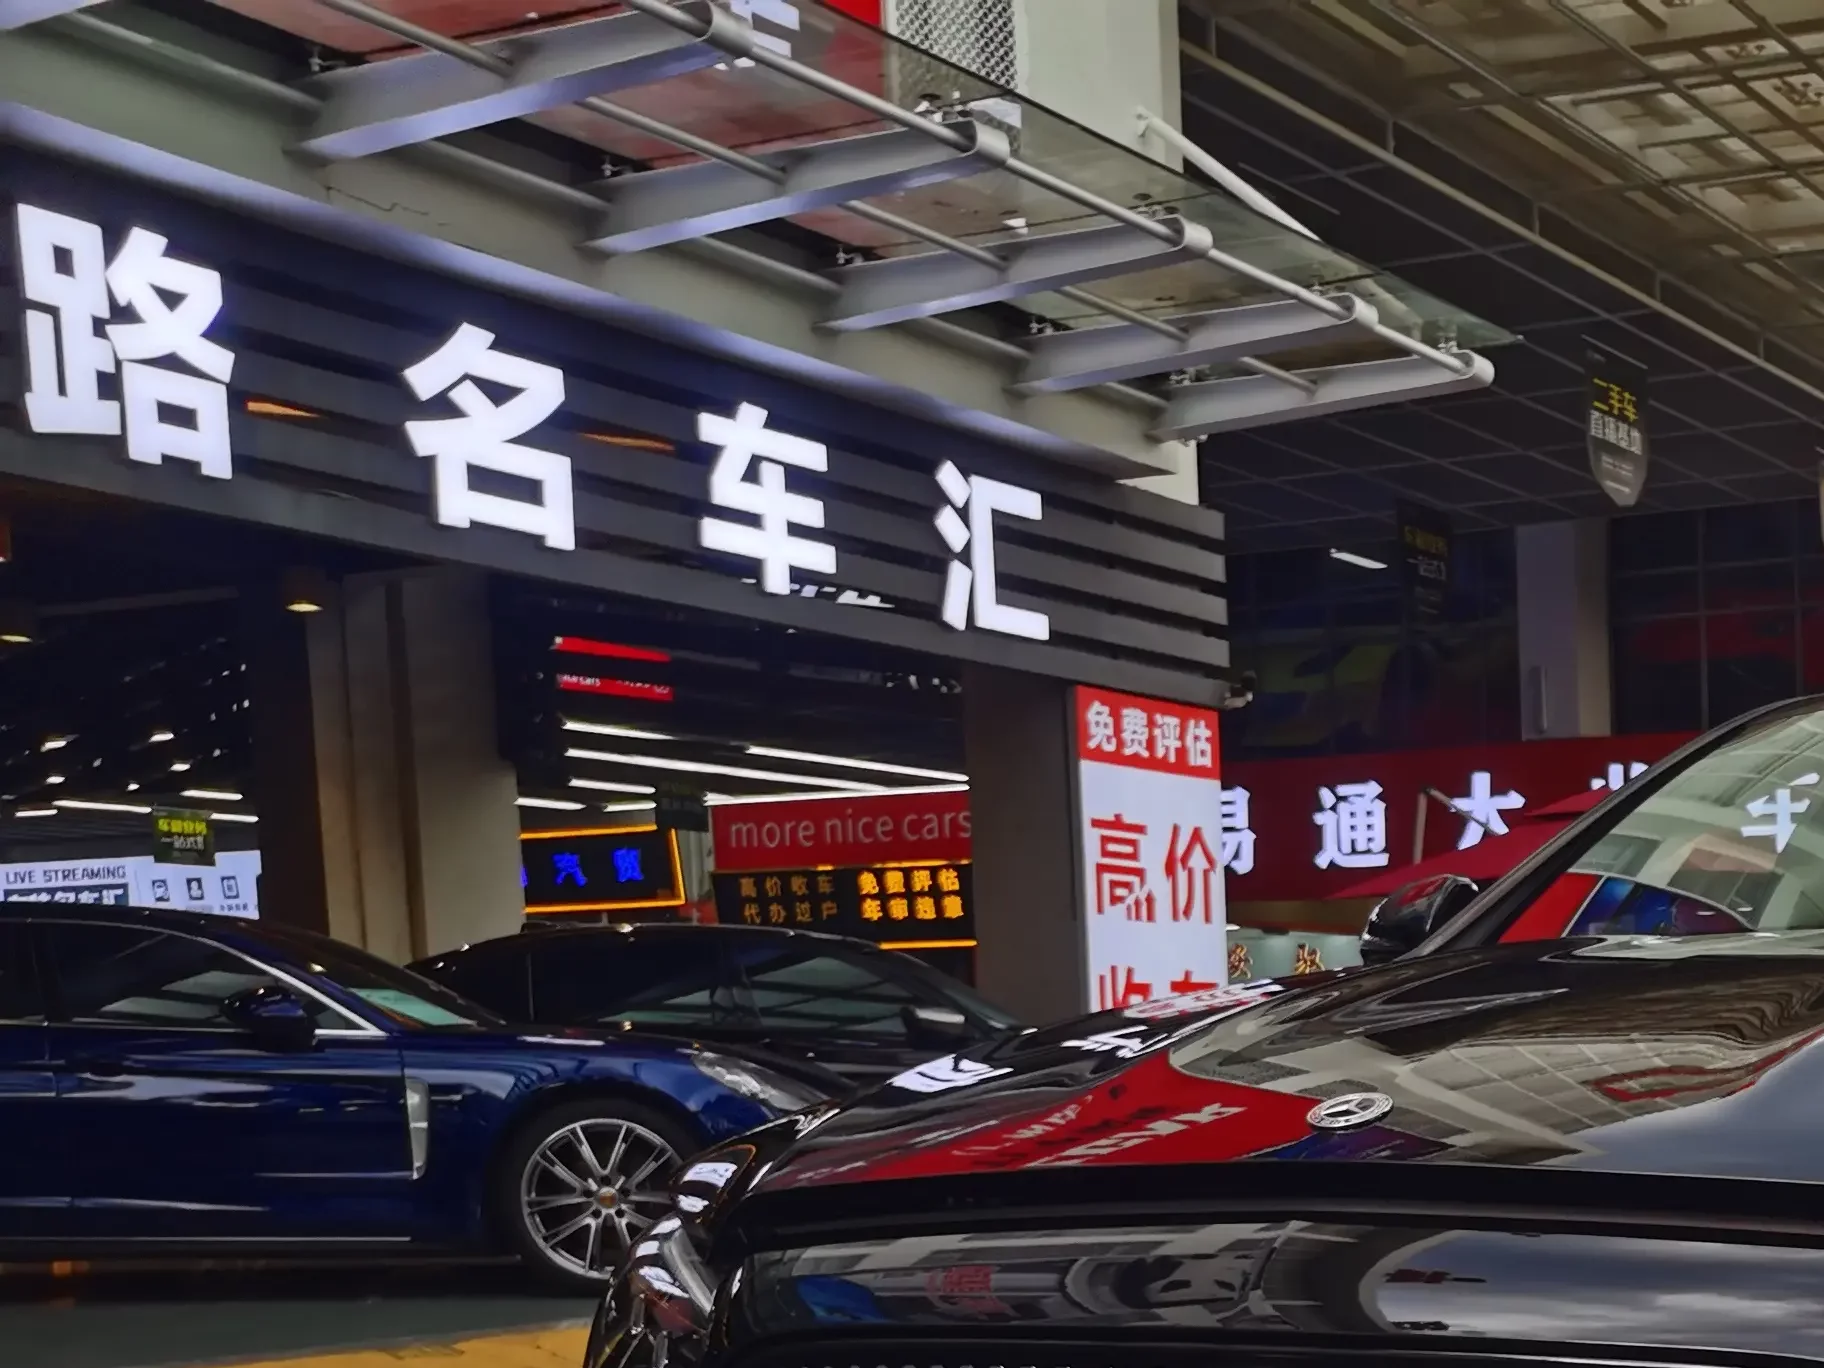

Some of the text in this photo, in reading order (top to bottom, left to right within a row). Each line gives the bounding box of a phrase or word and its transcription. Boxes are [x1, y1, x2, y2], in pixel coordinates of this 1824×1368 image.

[1592, 377, 1639, 422] 二手车
[16, 203, 1051, 642] 路名车汇
[1086, 700, 1214, 769] 免费评估
[730, 808, 972, 848] more nice cars
[5, 865, 126, 885] LIVE STREAMING
[739, 869, 961, 899] 高价收车 免费评估
[1091, 813, 1218, 924] 高价
[742, 900, 839, 924] 代办过户
